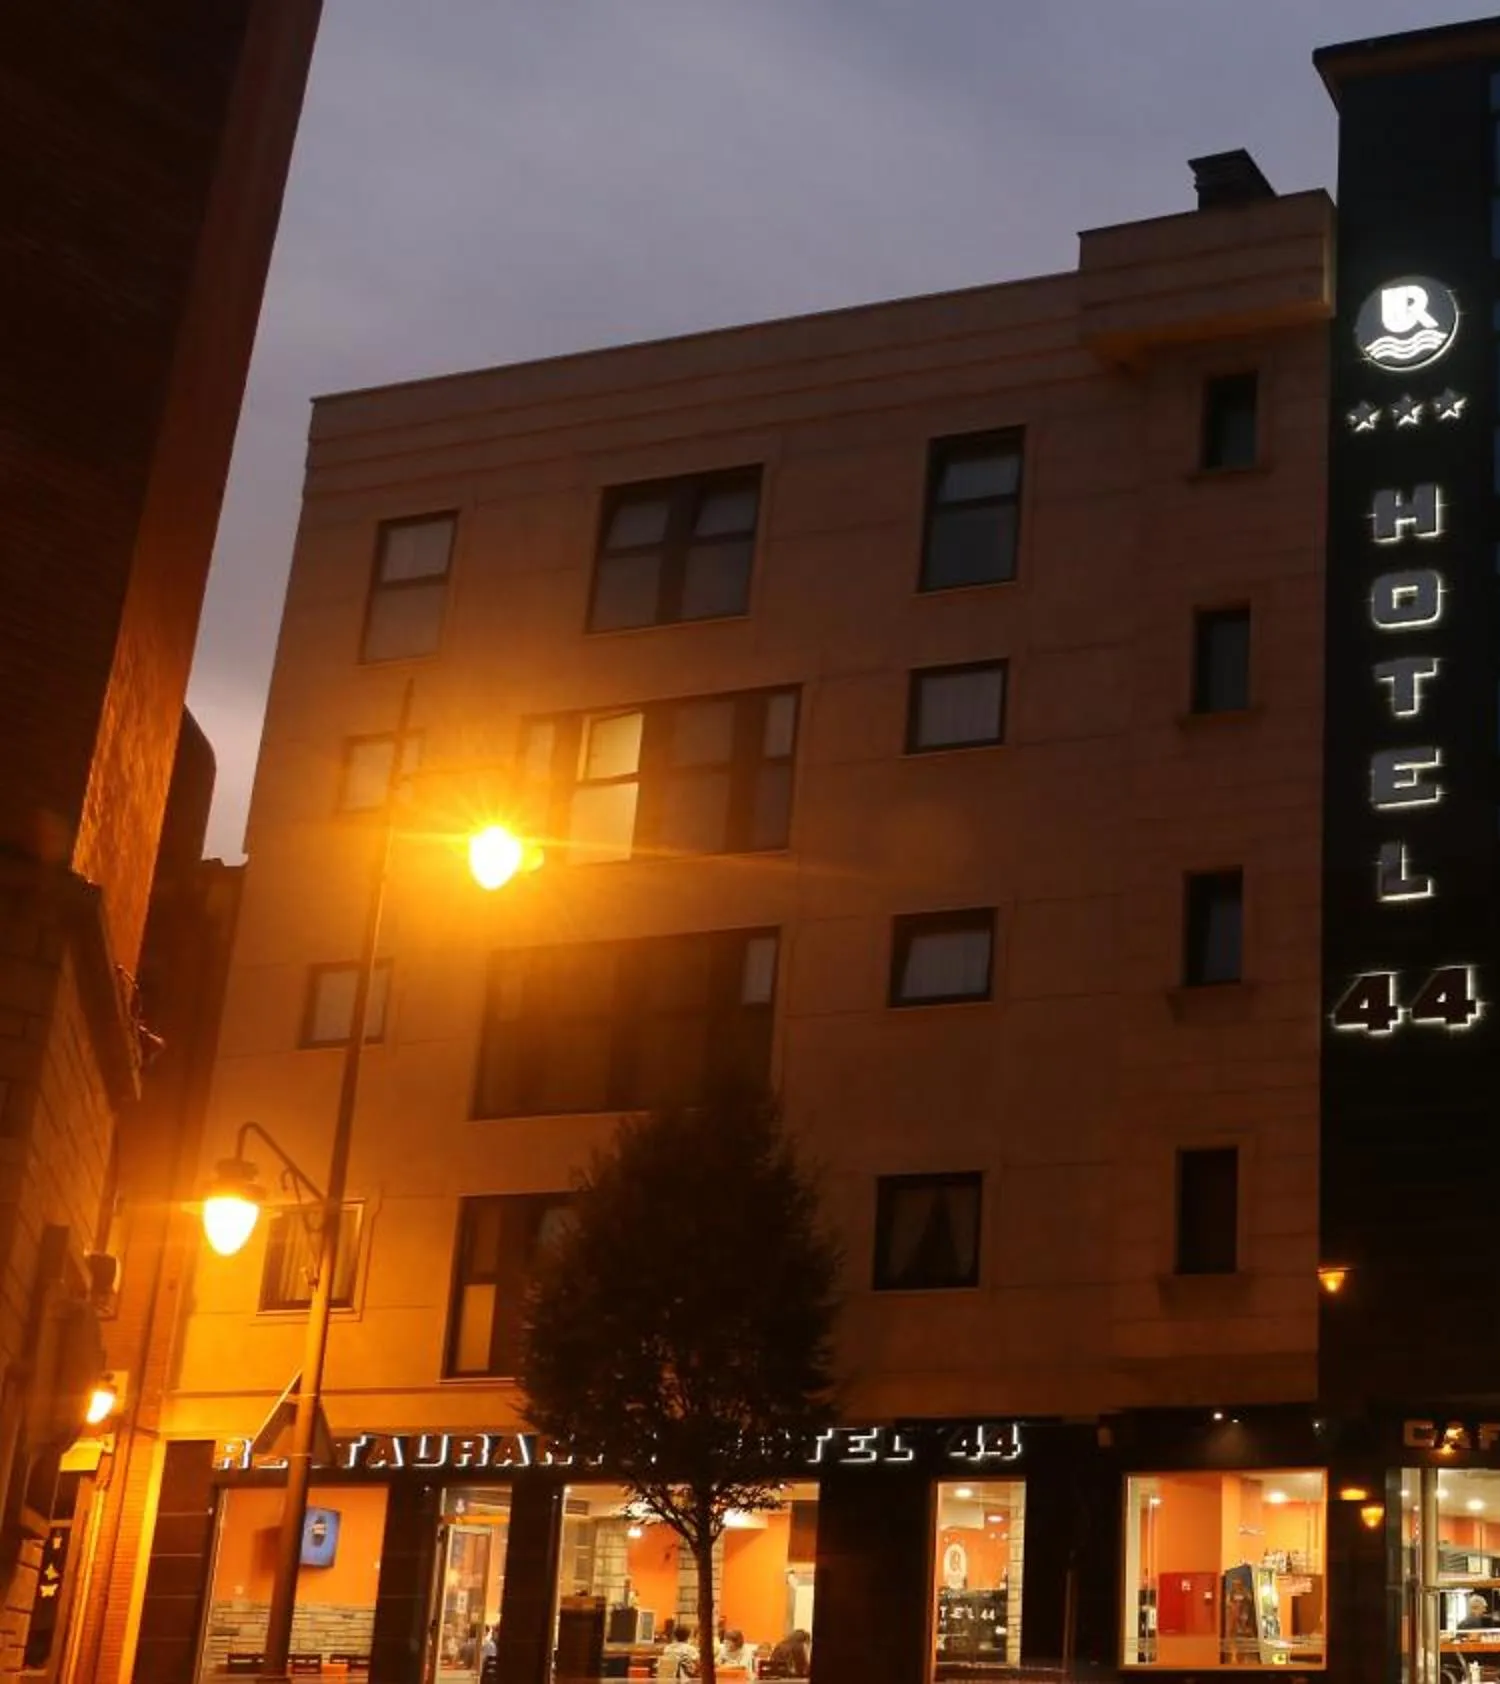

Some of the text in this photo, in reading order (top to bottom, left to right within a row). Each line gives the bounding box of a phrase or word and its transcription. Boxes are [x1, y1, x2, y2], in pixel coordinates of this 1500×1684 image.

[1329, 482, 1481, 1037] HOTEL 44
[946, 1422, 1023, 1462] 44
